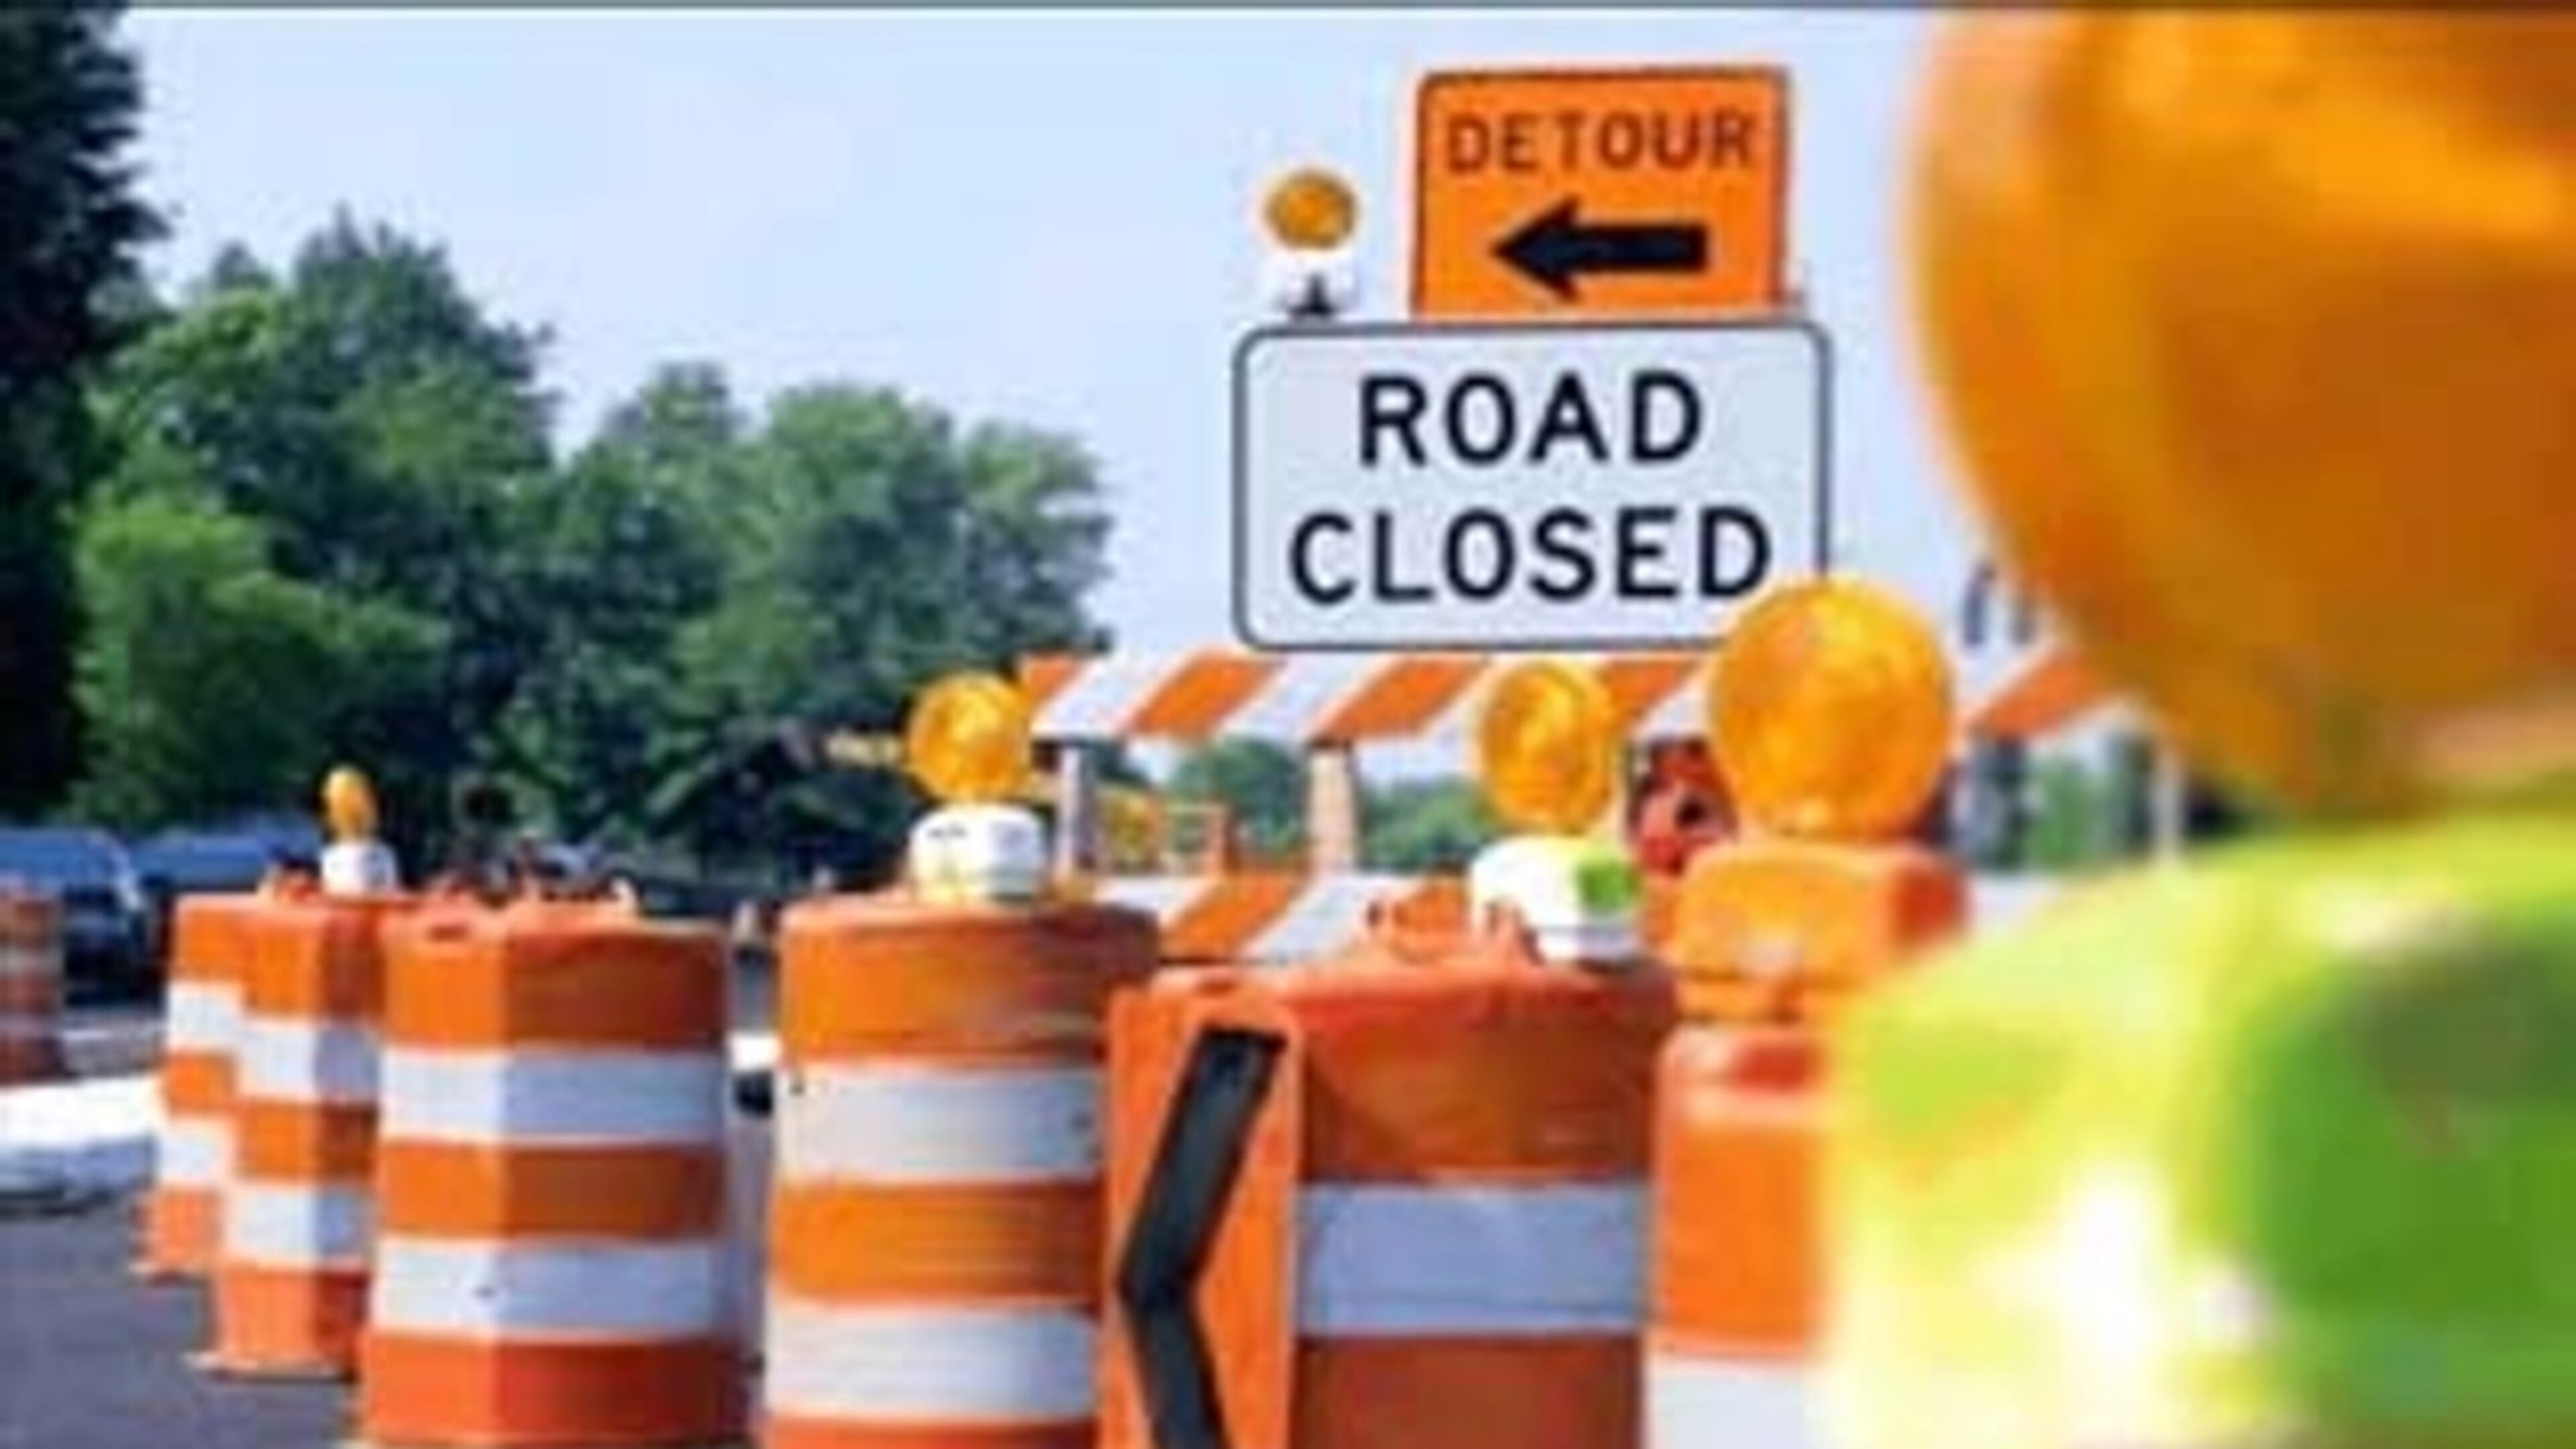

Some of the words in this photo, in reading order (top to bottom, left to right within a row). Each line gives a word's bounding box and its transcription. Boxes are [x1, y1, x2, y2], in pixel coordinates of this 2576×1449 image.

[1446, 110, 1756, 174] DETOUR
[1359, 370, 1701, 466] ROAD
[1289, 505, 1772, 606] CLOSED
